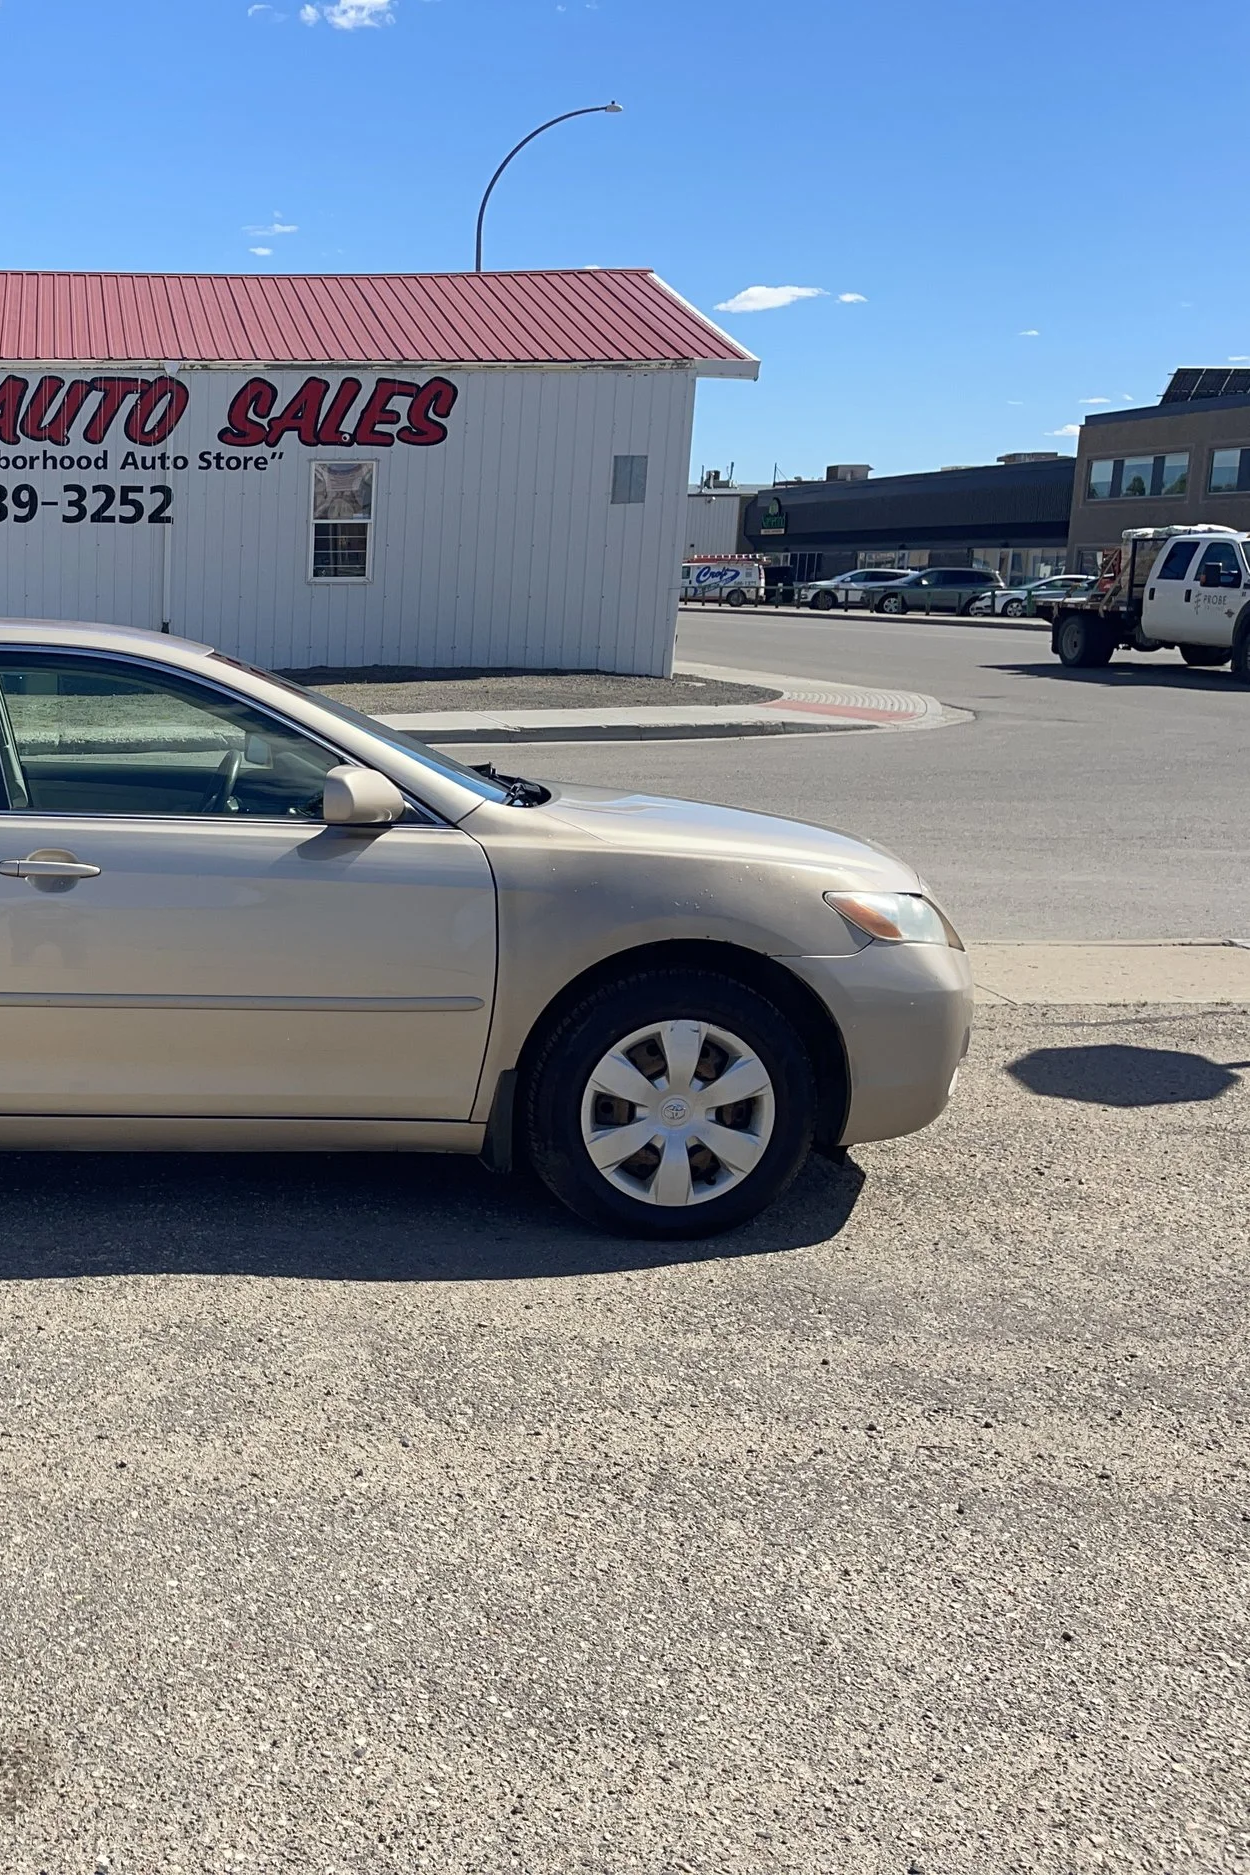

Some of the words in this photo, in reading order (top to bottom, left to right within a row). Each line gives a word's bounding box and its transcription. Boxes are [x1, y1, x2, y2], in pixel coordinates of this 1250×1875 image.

[217, 376, 459, 447] SALES
[120, 451, 189, 470] Auto
[1203, 595, 1227, 605] PROBE
